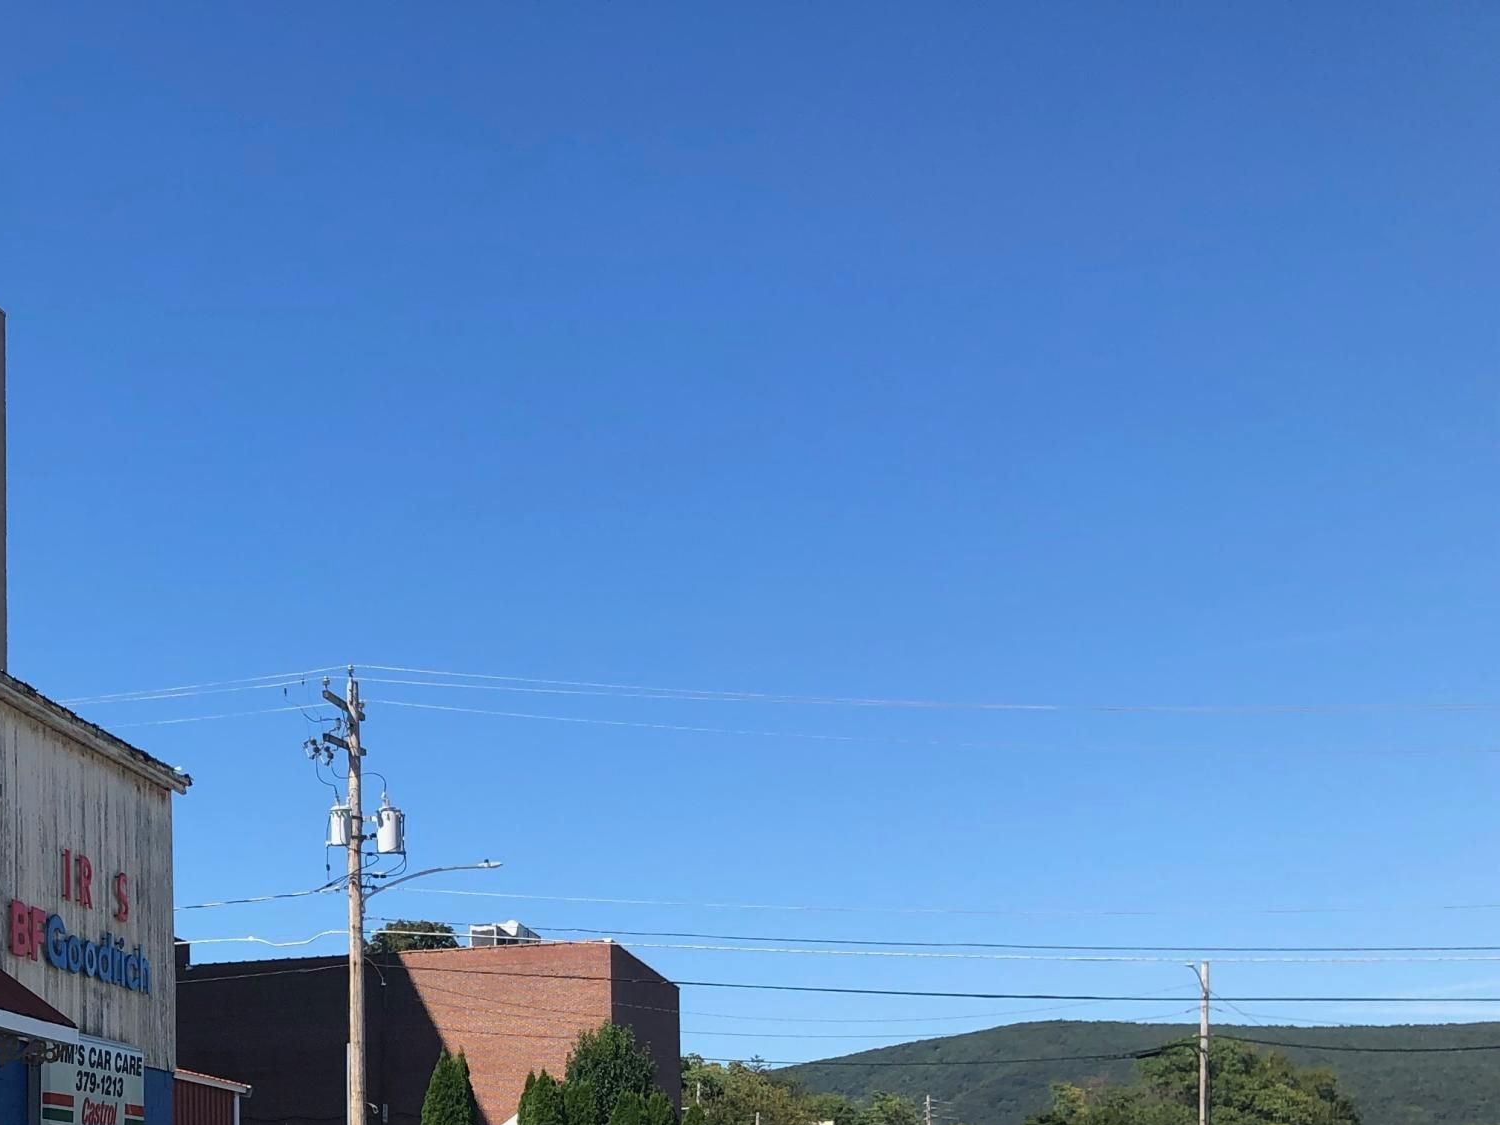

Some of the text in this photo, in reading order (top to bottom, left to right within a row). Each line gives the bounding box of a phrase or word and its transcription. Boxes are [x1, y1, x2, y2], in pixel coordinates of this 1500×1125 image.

[88, 1046, 112, 1072] CAR
[114, 1052, 143, 1078] CARE
[75, 1070, 124, 1099] 379-1213
